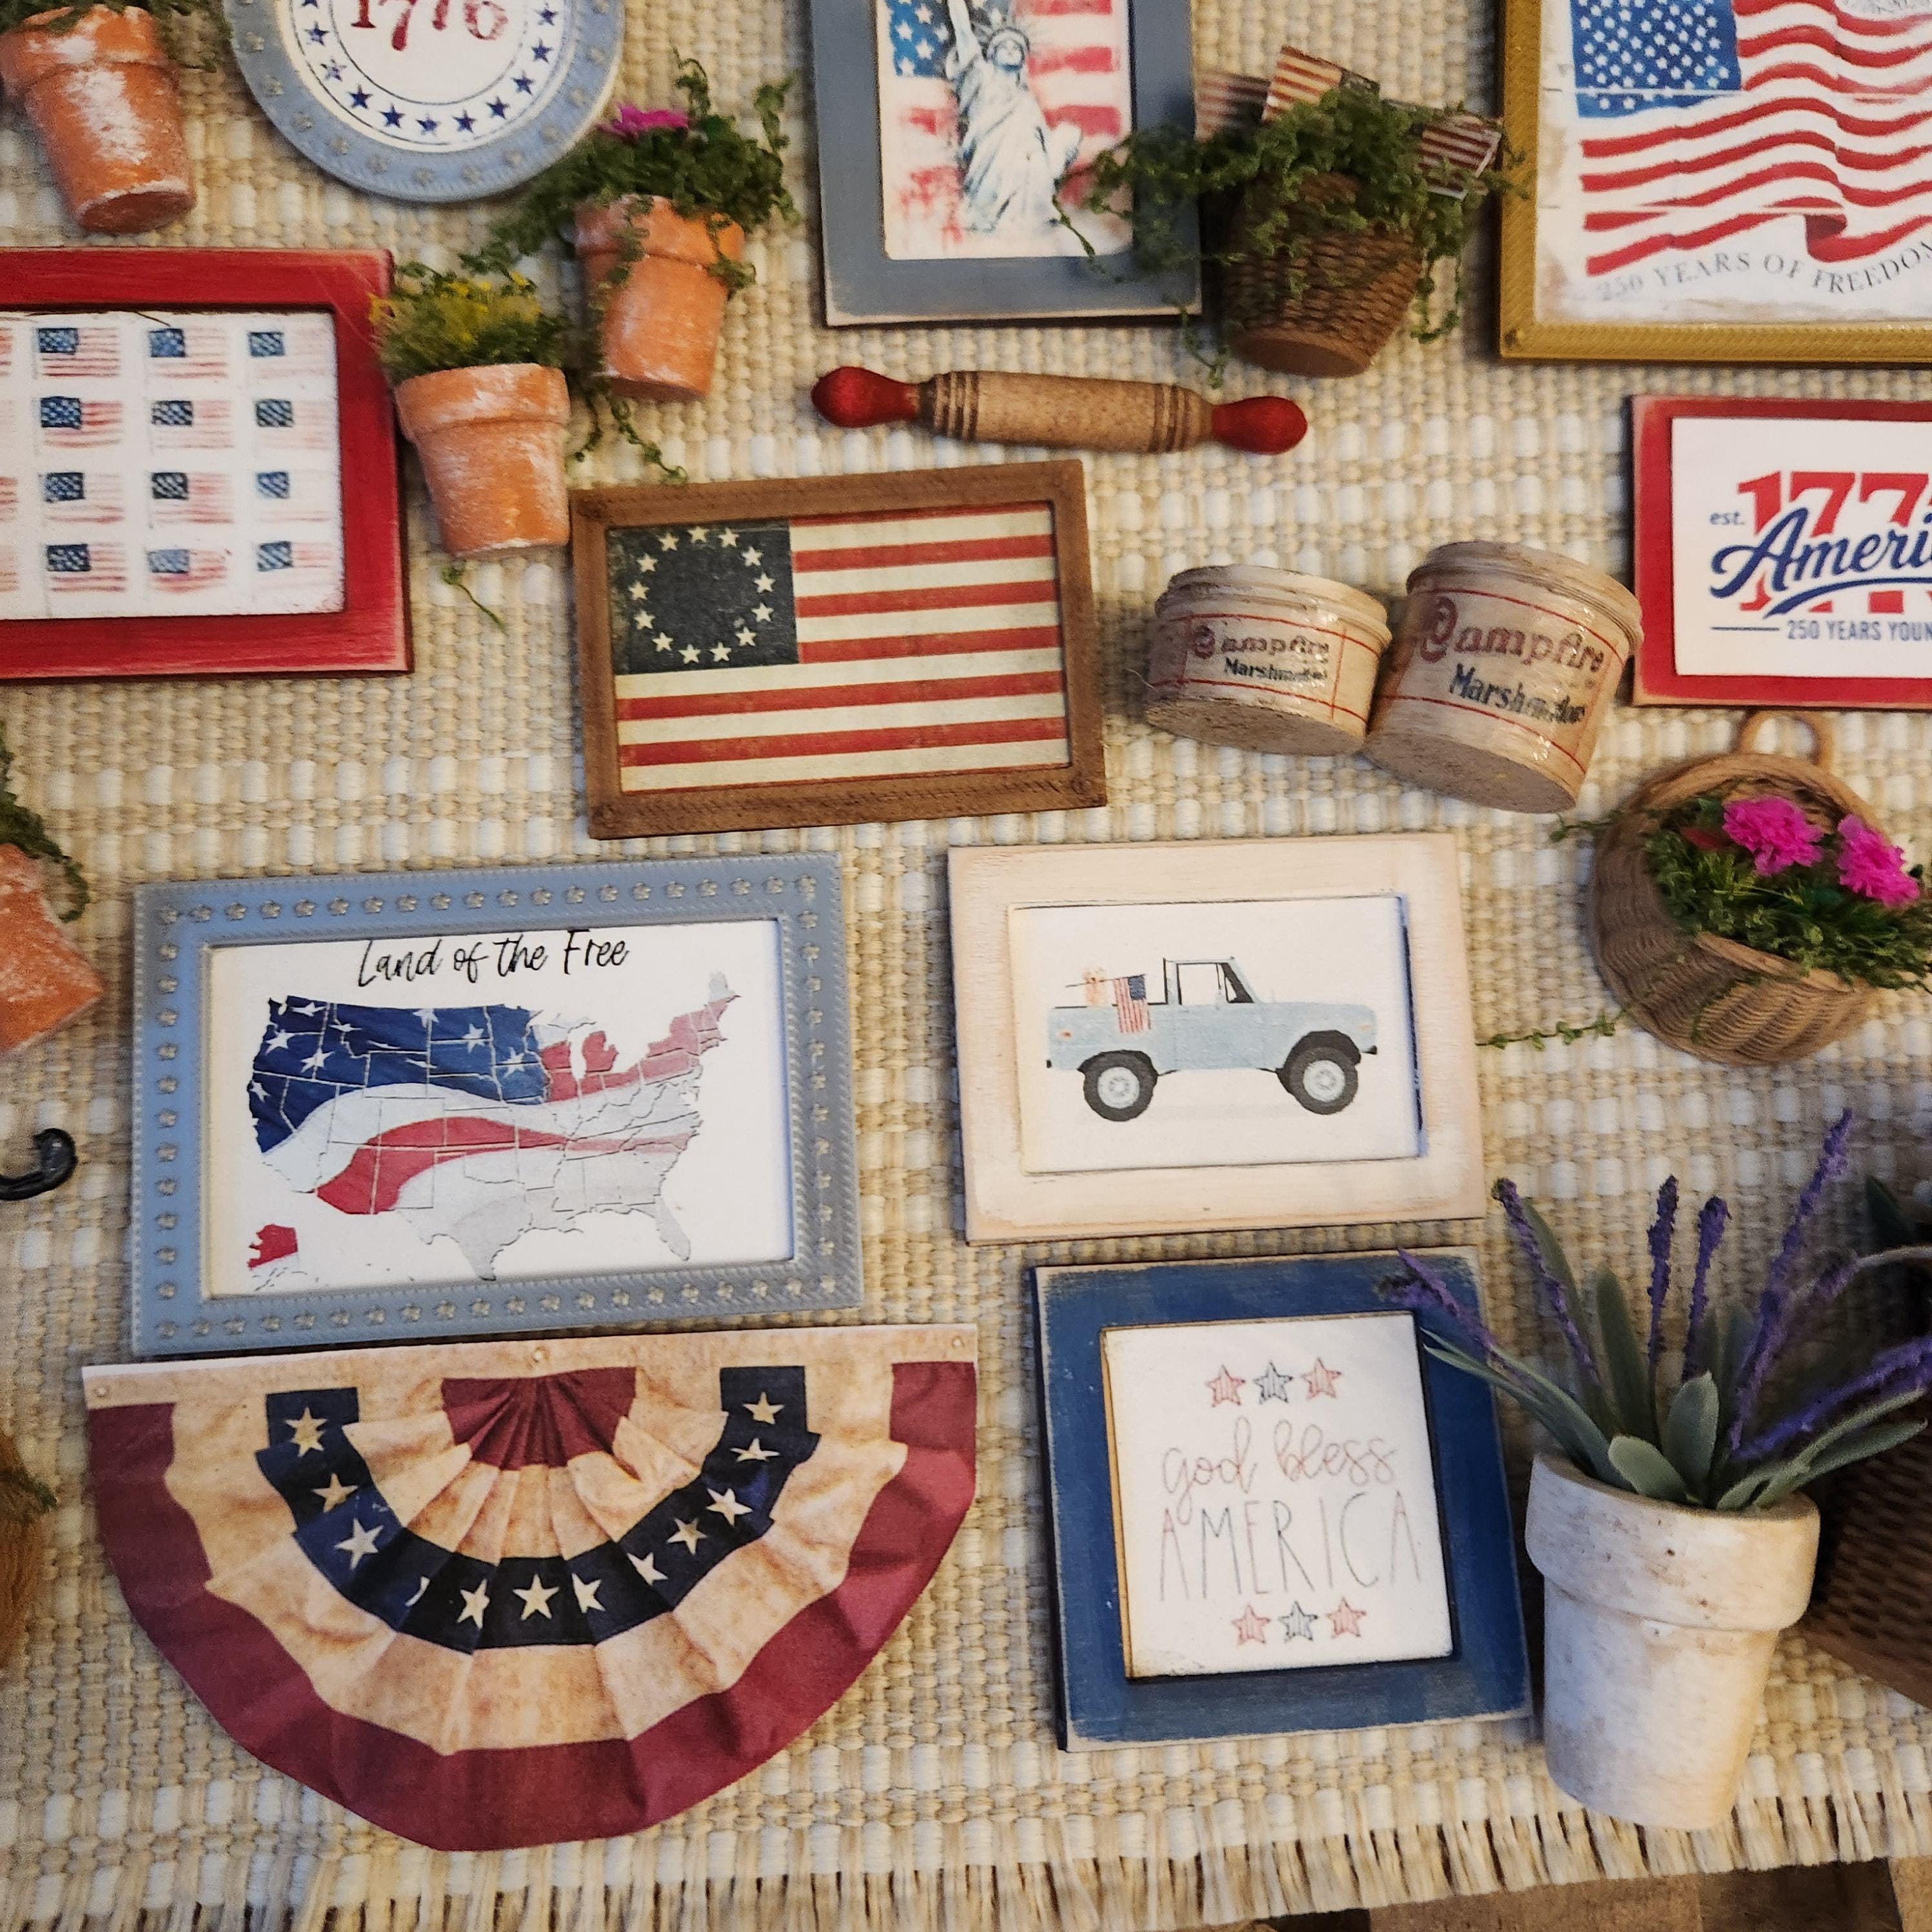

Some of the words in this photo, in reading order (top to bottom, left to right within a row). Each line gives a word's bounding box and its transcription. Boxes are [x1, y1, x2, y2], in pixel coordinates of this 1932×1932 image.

[1598, 274, 1643, 300] 250
[1653, 252, 1751, 287] YEARS
[1763, 254, 1806, 279] OF
[1709, 511, 1745, 526] est.
[1709, 507, 1932, 598] Ameri
[1737, 471, 1932, 613] 177
[1787, 619, 1820, 640] 250
[1825, 621, 1882, 641] YEARS
[357, 938, 444, 987] Land
[453, 941, 489, 983] of
[563, 929, 632, 975] Free
[1162, 1415, 1259, 1526] god
[1273, 1419, 1398, 1486] bless
[1160, 1490, 1421, 1602] AMERICA
